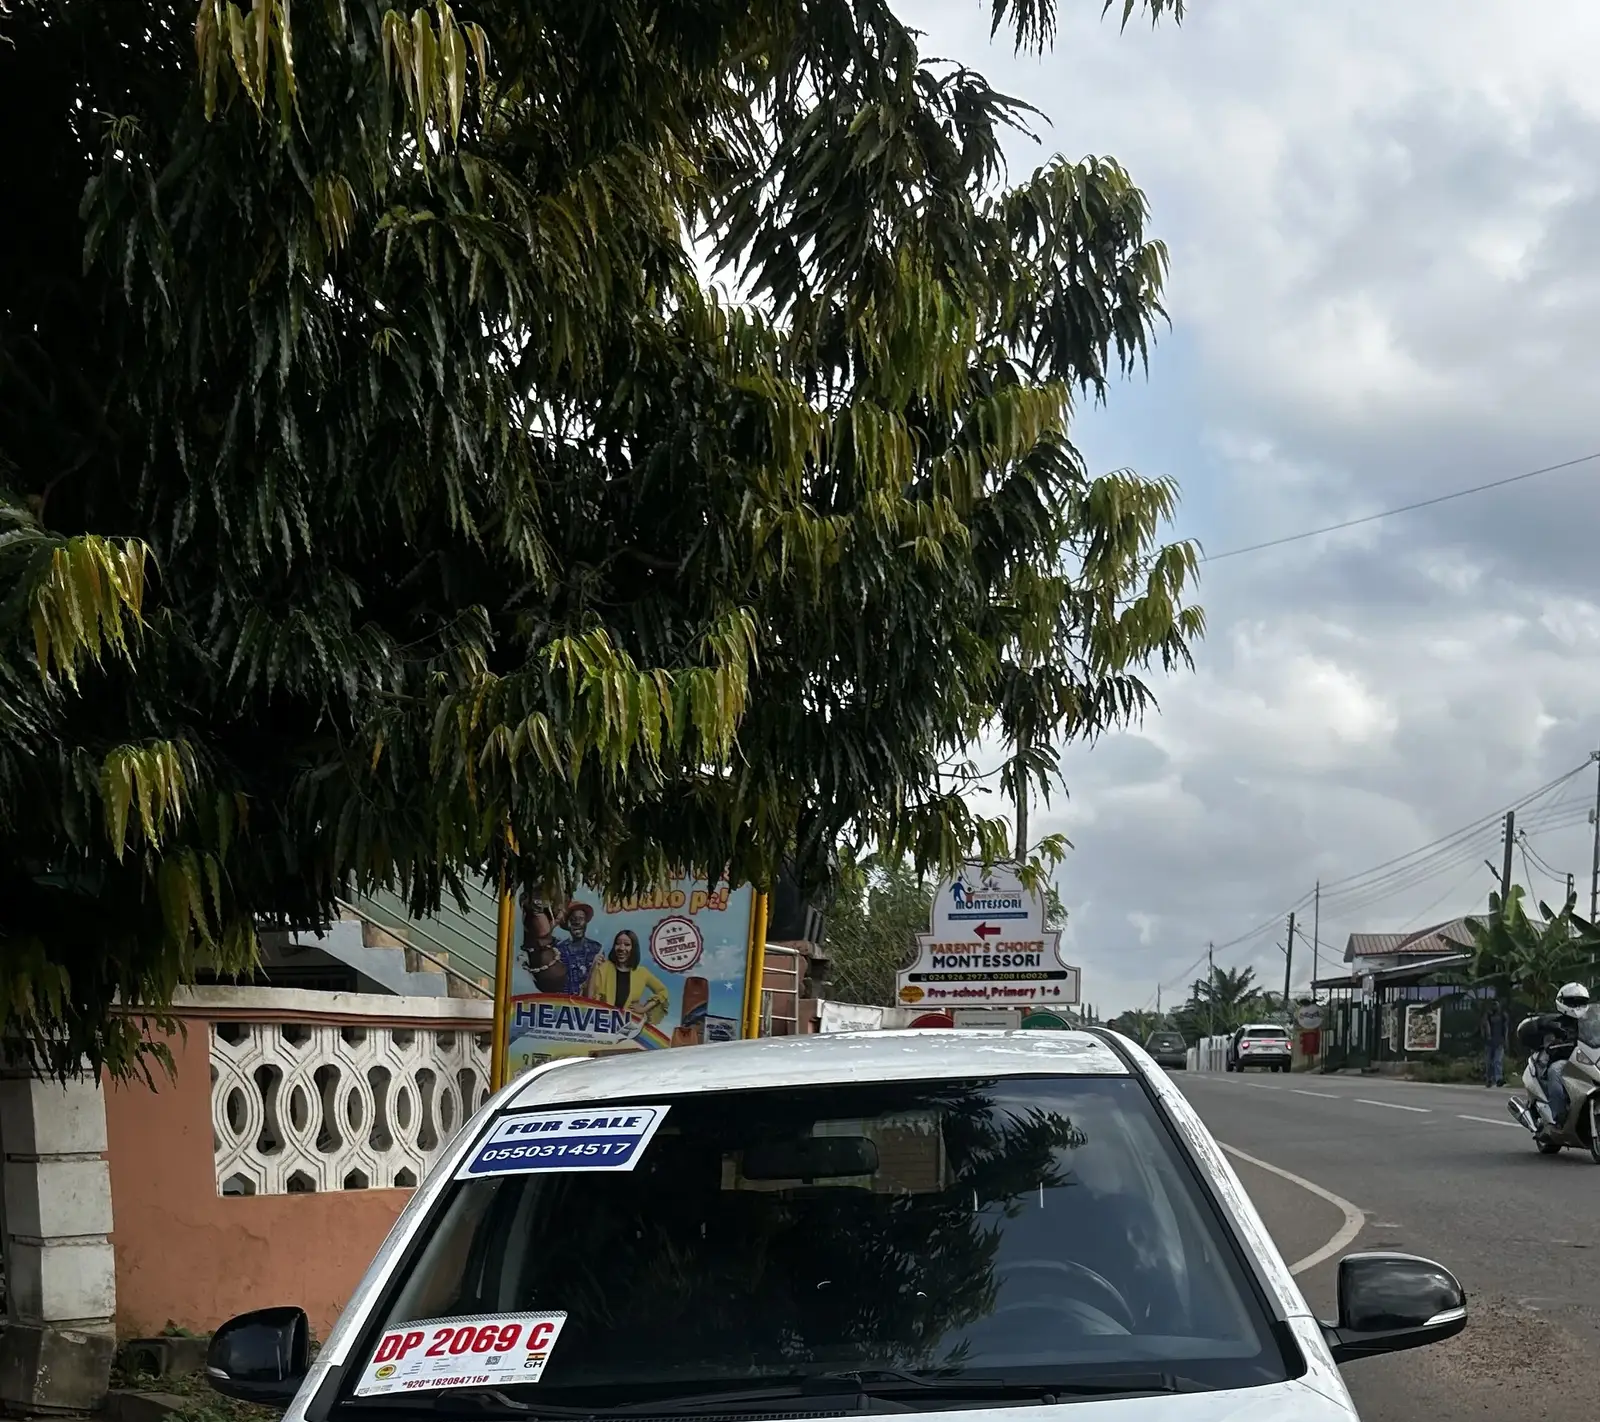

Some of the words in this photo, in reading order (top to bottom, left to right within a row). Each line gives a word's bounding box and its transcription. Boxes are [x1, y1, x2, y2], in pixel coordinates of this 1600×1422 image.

[956, 898, 1022, 910] MONTESSORI
[666, 936, 686, 946] NEW
[930, 943, 991, 955] PARENT'S
[996, 940, 1044, 953] CHOICE
[658, 942, 697, 955] PERFUME
[932, 954, 1041, 969] MONTESSORI
[928, 973, 945, 981] 024
[991, 986, 1037, 999] Primary
[1040, 986, 1061, 997] 1-6
[516, 1002, 631, 1034] HEAVEN
[504, 1120, 562, 1136] FOR
[567, 1116, 643, 1130] SALE
[481, 1143, 632, 1162] 0550314517
[373, 1331, 425, 1363] DP
[424, 1323, 523, 1357] 2069
[526, 1322, 555, 1351] C
[523, 1361, 544, 1369] GH
